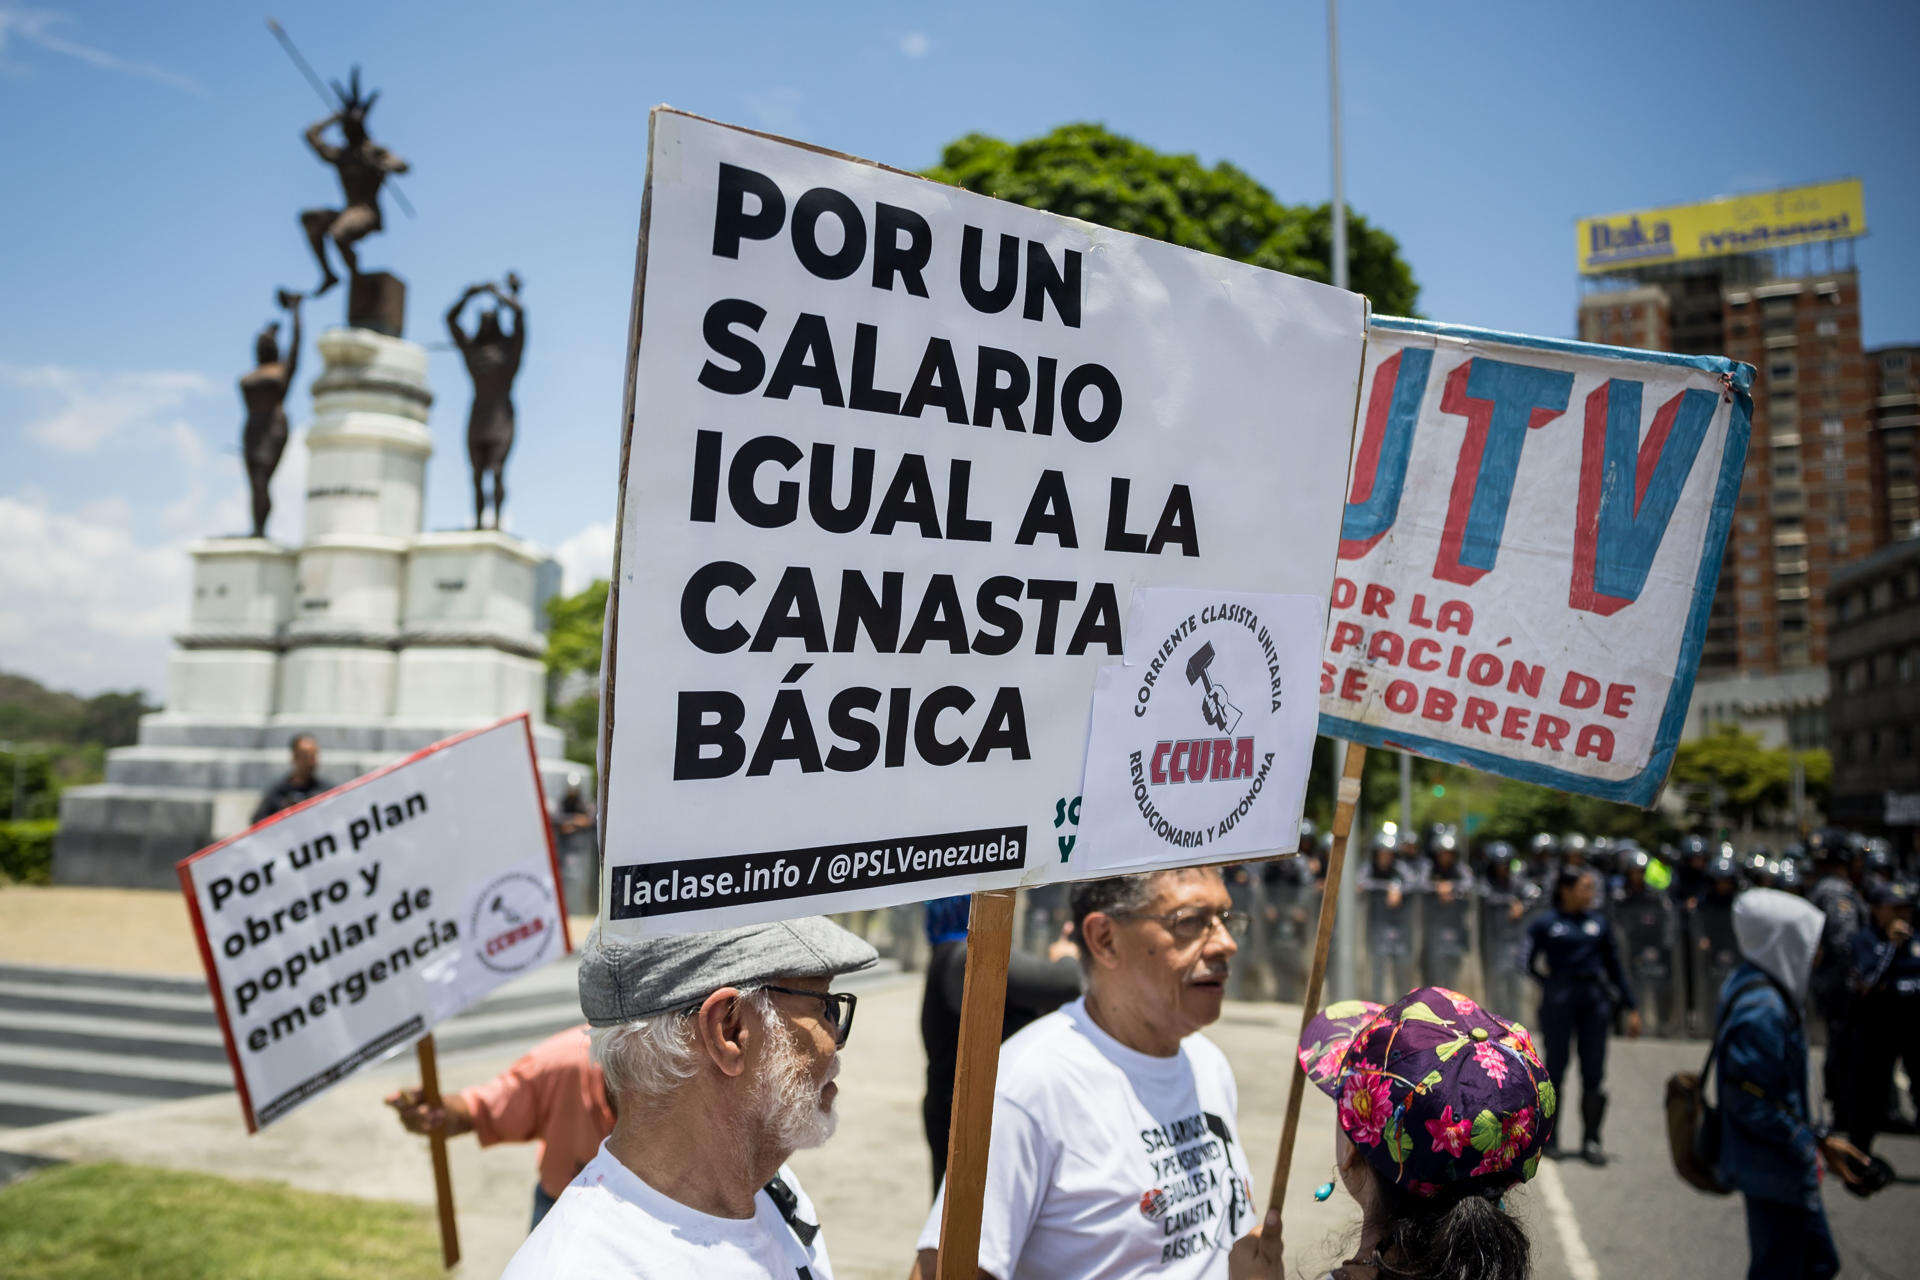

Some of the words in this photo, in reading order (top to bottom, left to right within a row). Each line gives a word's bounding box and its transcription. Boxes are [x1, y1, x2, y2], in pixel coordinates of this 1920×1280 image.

[712, 162, 932, 298] POR
[960, 224, 1082, 328] UN
[697, 299, 1122, 442] SALARIO
[690, 430, 992, 542] IGUAL
[1015, 469, 1079, 549] A
[1104, 477, 1200, 557] LA
[680, 561, 1123, 656] CANASTA
[1331, 577, 1395, 619] OR
[1409, 594, 1474, 636] LA
[1134, 614, 1197, 717] CORRIENTE
[1201, 603, 1258, 633] CLASISTA
[1258, 626, 1282, 714] UNITARIA
[1330, 621, 1546, 699] PACIÓN
[1559, 670, 1636, 719] DE
[673, 663, 1031, 781] BÁSICA
[1320, 661, 1368, 702] SE
[1384, 679, 1615, 762] OBRERA
[1130, 751, 1203, 848] REVOLUCIONARIA
[1207, 827, 1215, 843] Y
[1218, 752, 1275, 838] AUTÓNOMA
[1150, 736, 1255, 786] CCURA
[209, 861, 275, 911] Por
[288, 832, 336, 871] un
[349, 792, 428, 850] plan
[624, 860, 799, 906] laclase.info
[807, 856, 820, 886] /
[827, 835, 1020, 884] @PSLVenezuela
[1058, 834, 1076, 863] Y
[223, 878, 349, 959] obrero
[360, 861, 381, 896] y
[235, 914, 379, 1015] popular
[391, 886, 432, 923] de
[246, 917, 459, 1052] emergencia
[1150, 1160, 1161, 1181] Y
[1164, 1199, 1217, 1237] CANASTA
[1209, 1169, 1218, 1190] A
